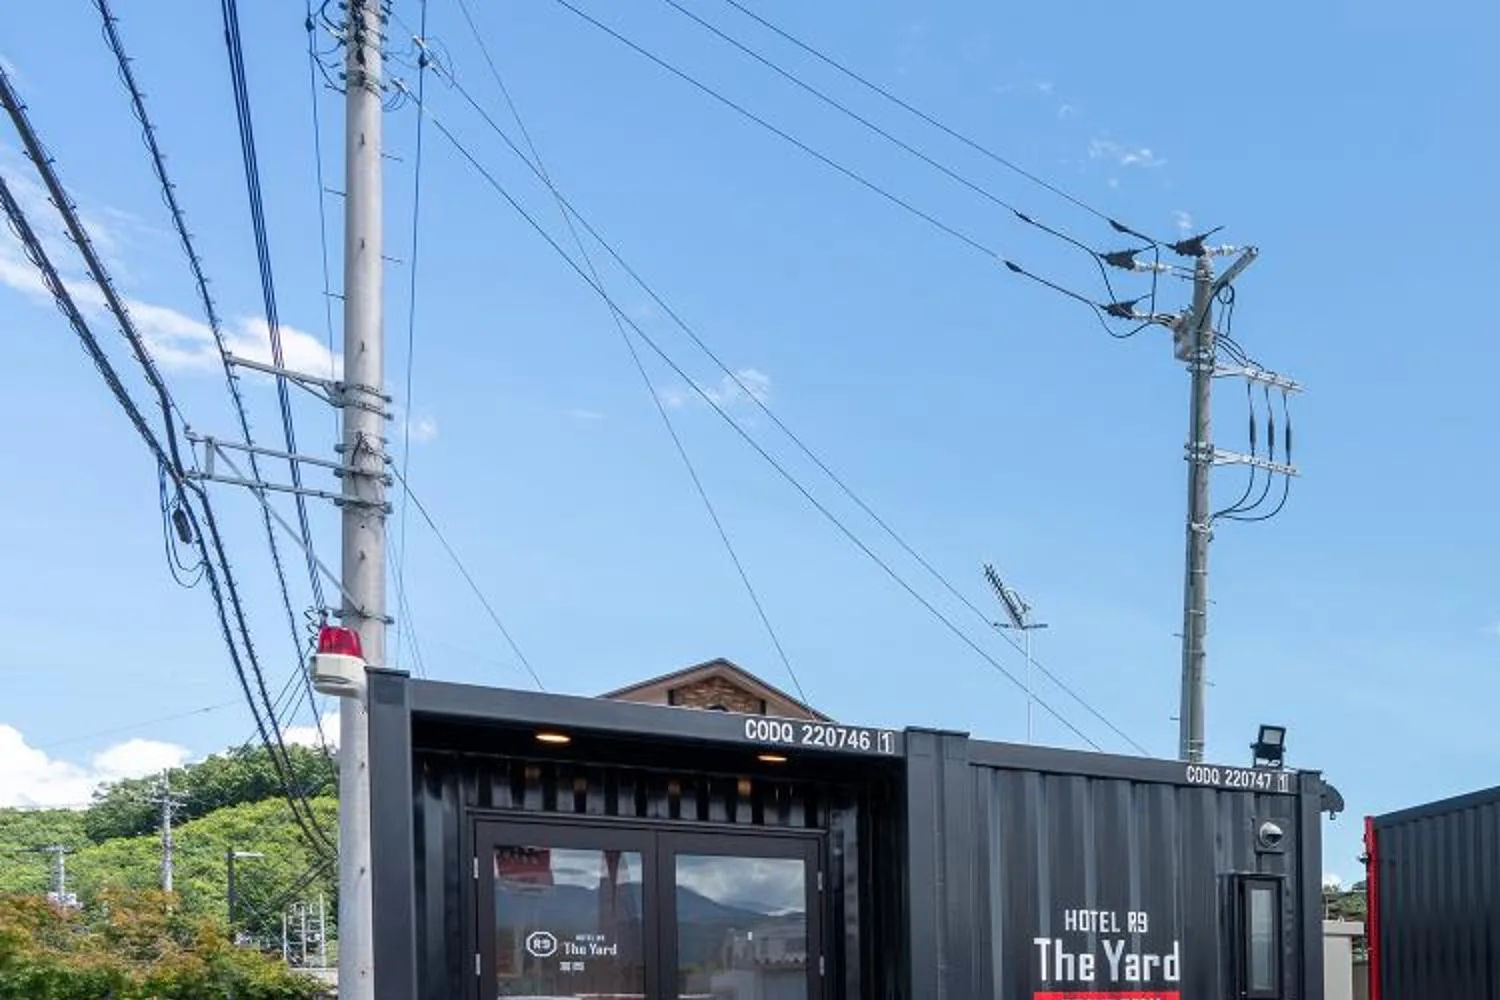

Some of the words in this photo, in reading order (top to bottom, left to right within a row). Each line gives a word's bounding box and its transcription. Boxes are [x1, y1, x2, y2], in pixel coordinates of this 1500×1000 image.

[745, 719, 793, 742] CODQ
[801, 725, 870, 750] 220746
[879, 732, 893, 753] 1
[1186, 765, 1220, 785] CODQ
[1225, 769, 1271, 789] 220747
[1065, 909, 1121, 933] HOTEL
[1127, 911, 1149, 933] R9
[563, 942, 587, 956] The
[589, 943, 618, 956] Yard
[1033, 937, 1095, 982] The
[1102, 939, 1181, 982] Yard
